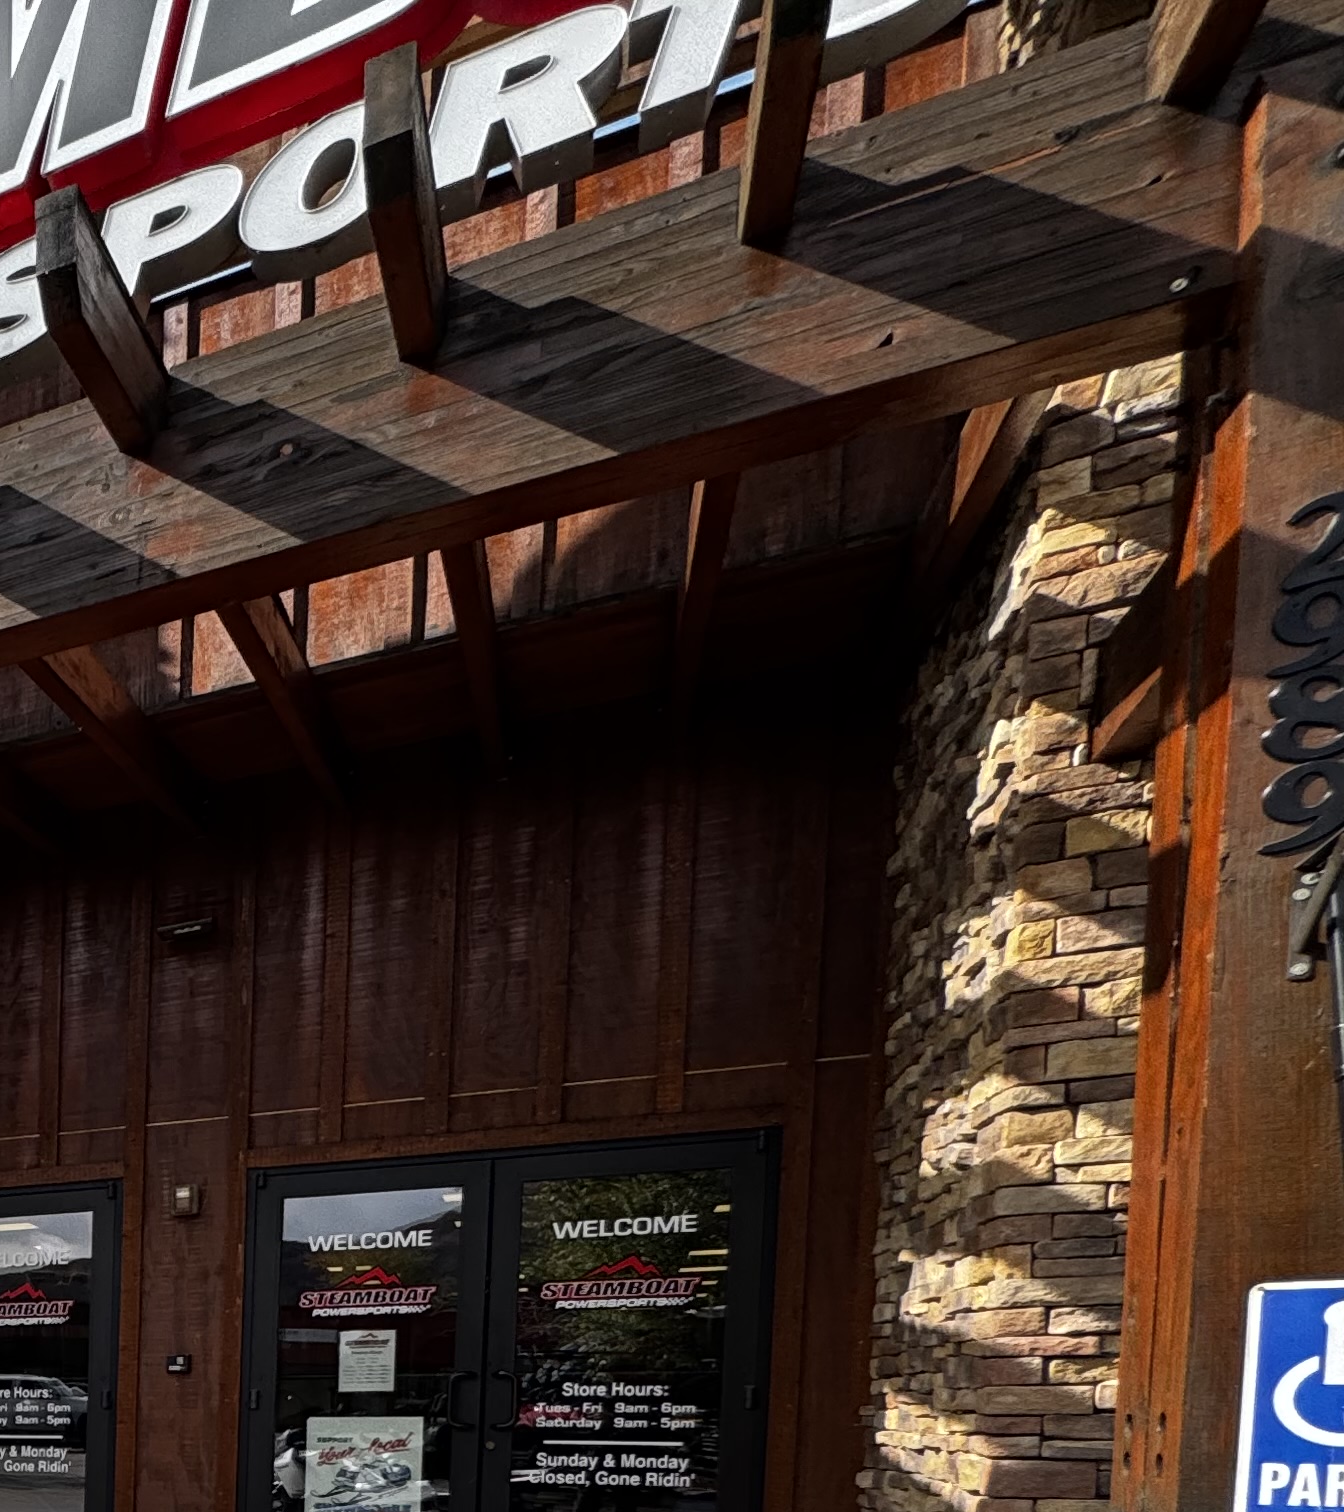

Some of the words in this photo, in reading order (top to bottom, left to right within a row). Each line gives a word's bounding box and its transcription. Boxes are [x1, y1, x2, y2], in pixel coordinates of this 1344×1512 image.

[552, 1214, 698, 1240] WELCOME
[308, 1229, 433, 1252] WELCOME
[540, 1276, 702, 1300] STEAMBOAT
[299, 1286, 437, 1308] STEAMBOAT
[554, 1297, 668, 1310] POWERSPORTS
[312, 1305, 409, 1317] POWERSPORTS
[13, 1386, 53, 1399] Hours:
[562, 1382, 607, 1397] Store
[611, 1382, 670, 1397] Hours:
[582, 1402, 603, 1413] Fri
[614, 1402, 648, 1413] 9am
[660, 1402, 696, 1416] 6pm
[535, 1416, 603, 1430] Saturday
[613, 1417, 648, 1428] 9am
[660, 1417, 695, 1430] 5pm
[9, 1446, 18, 1457] &
[21, 1446, 68, 1460] Monday
[4, 1460, 35, 1472] Gone
[38, 1460, 71, 1473] Ridin'
[535, 1452, 599, 1470] Sunday
[603, 1453, 616, 1467] &
[620, 1453, 690, 1473] Monday
[529, 1470, 591, 1487] Closed,
[594, 1471, 641, 1486] Gone
[645, 1472, 696, 1487] Ridin'
[1258, 1462, 1344, 1507] PAR
